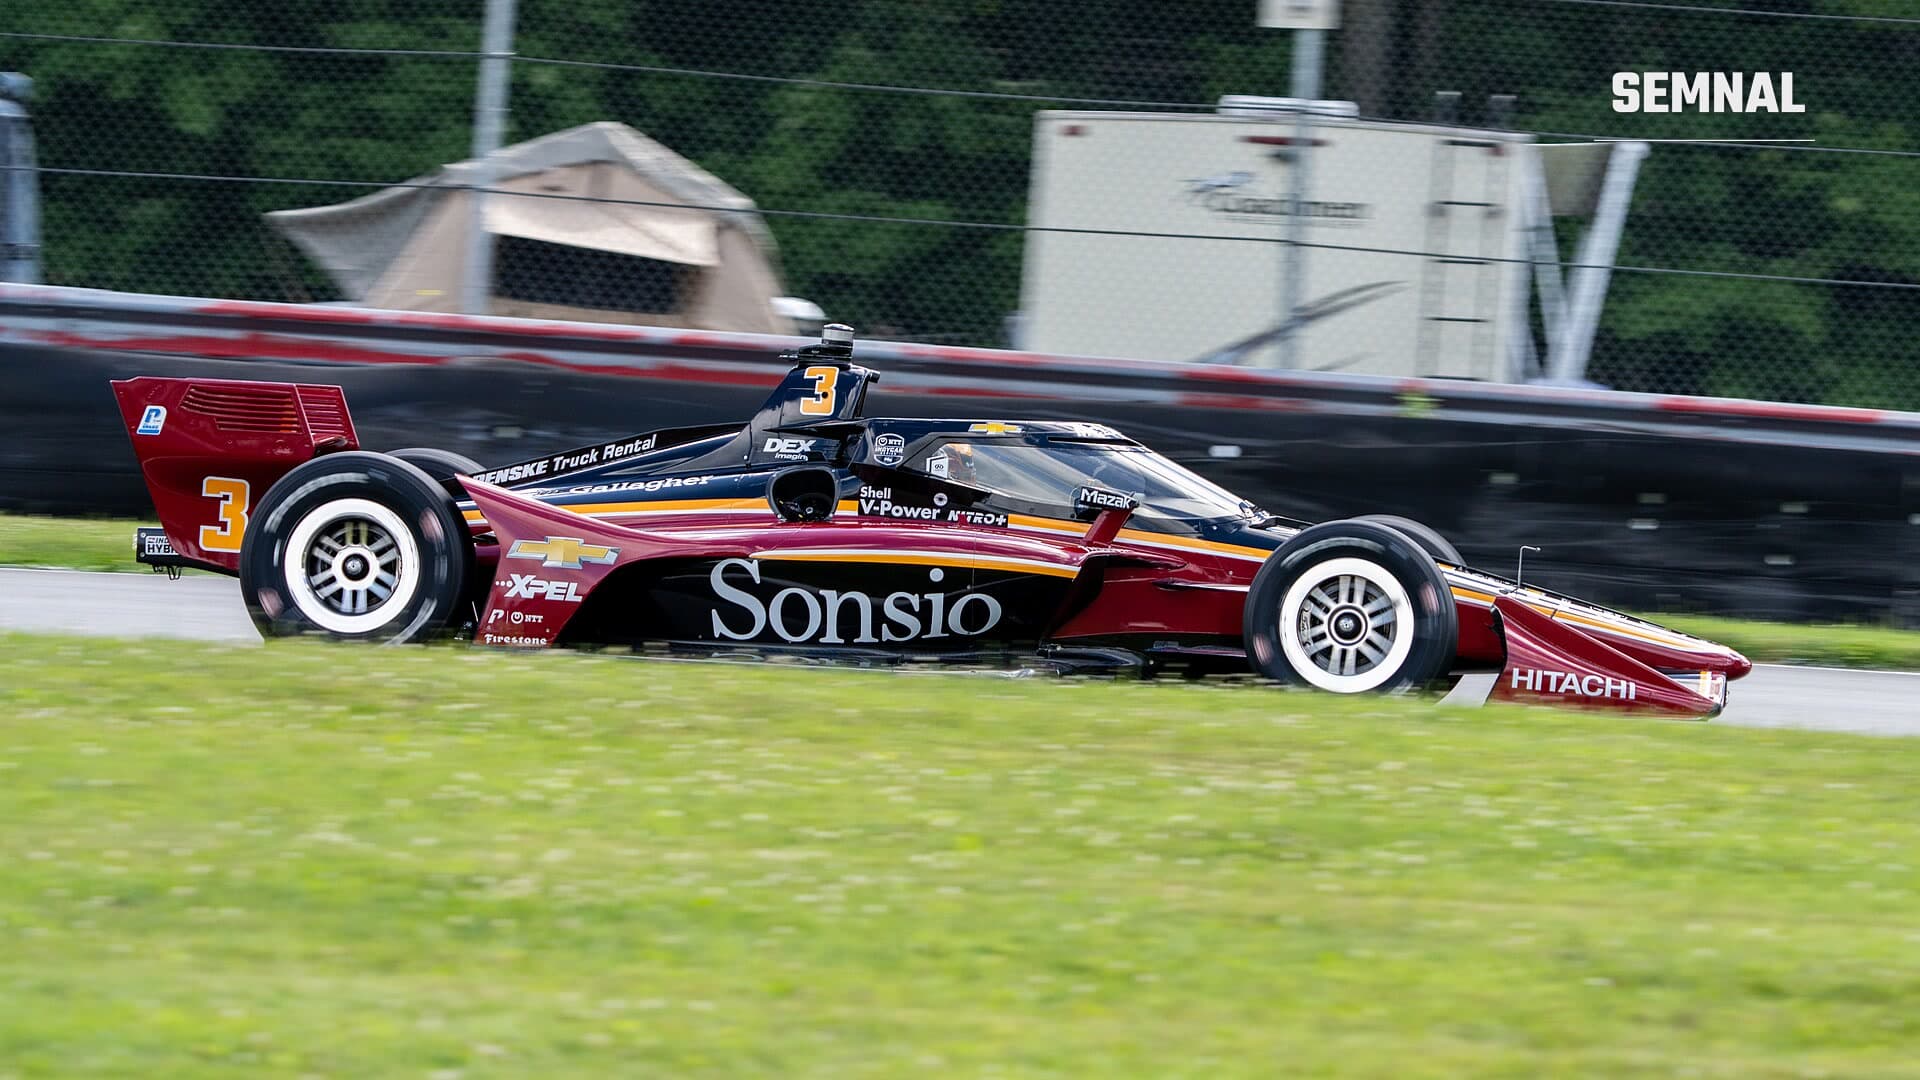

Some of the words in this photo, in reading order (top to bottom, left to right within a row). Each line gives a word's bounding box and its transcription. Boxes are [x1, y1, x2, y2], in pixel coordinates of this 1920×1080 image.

[799, 366, 840, 417] 3
[552, 450, 600, 472] Truck
[602, 433, 657, 461] Rental
[763, 437, 816, 453] DEX
[568, 474, 715, 492] Gallagher
[859, 485, 892, 499] Shell
[859, 498, 941, 521] V-Power
[947, 509, 1007, 526] NTRO+
[1080, 488, 1131, 509] Mazak
[199, 475, 250, 553] 3
[503, 573, 583, 602] XPEL
[710, 558, 1002, 643] Sonsio
[524, 614, 544, 623] NTT
[484, 633, 548, 645] Firestone
[1511, 667, 1636, 700] HITACHI
